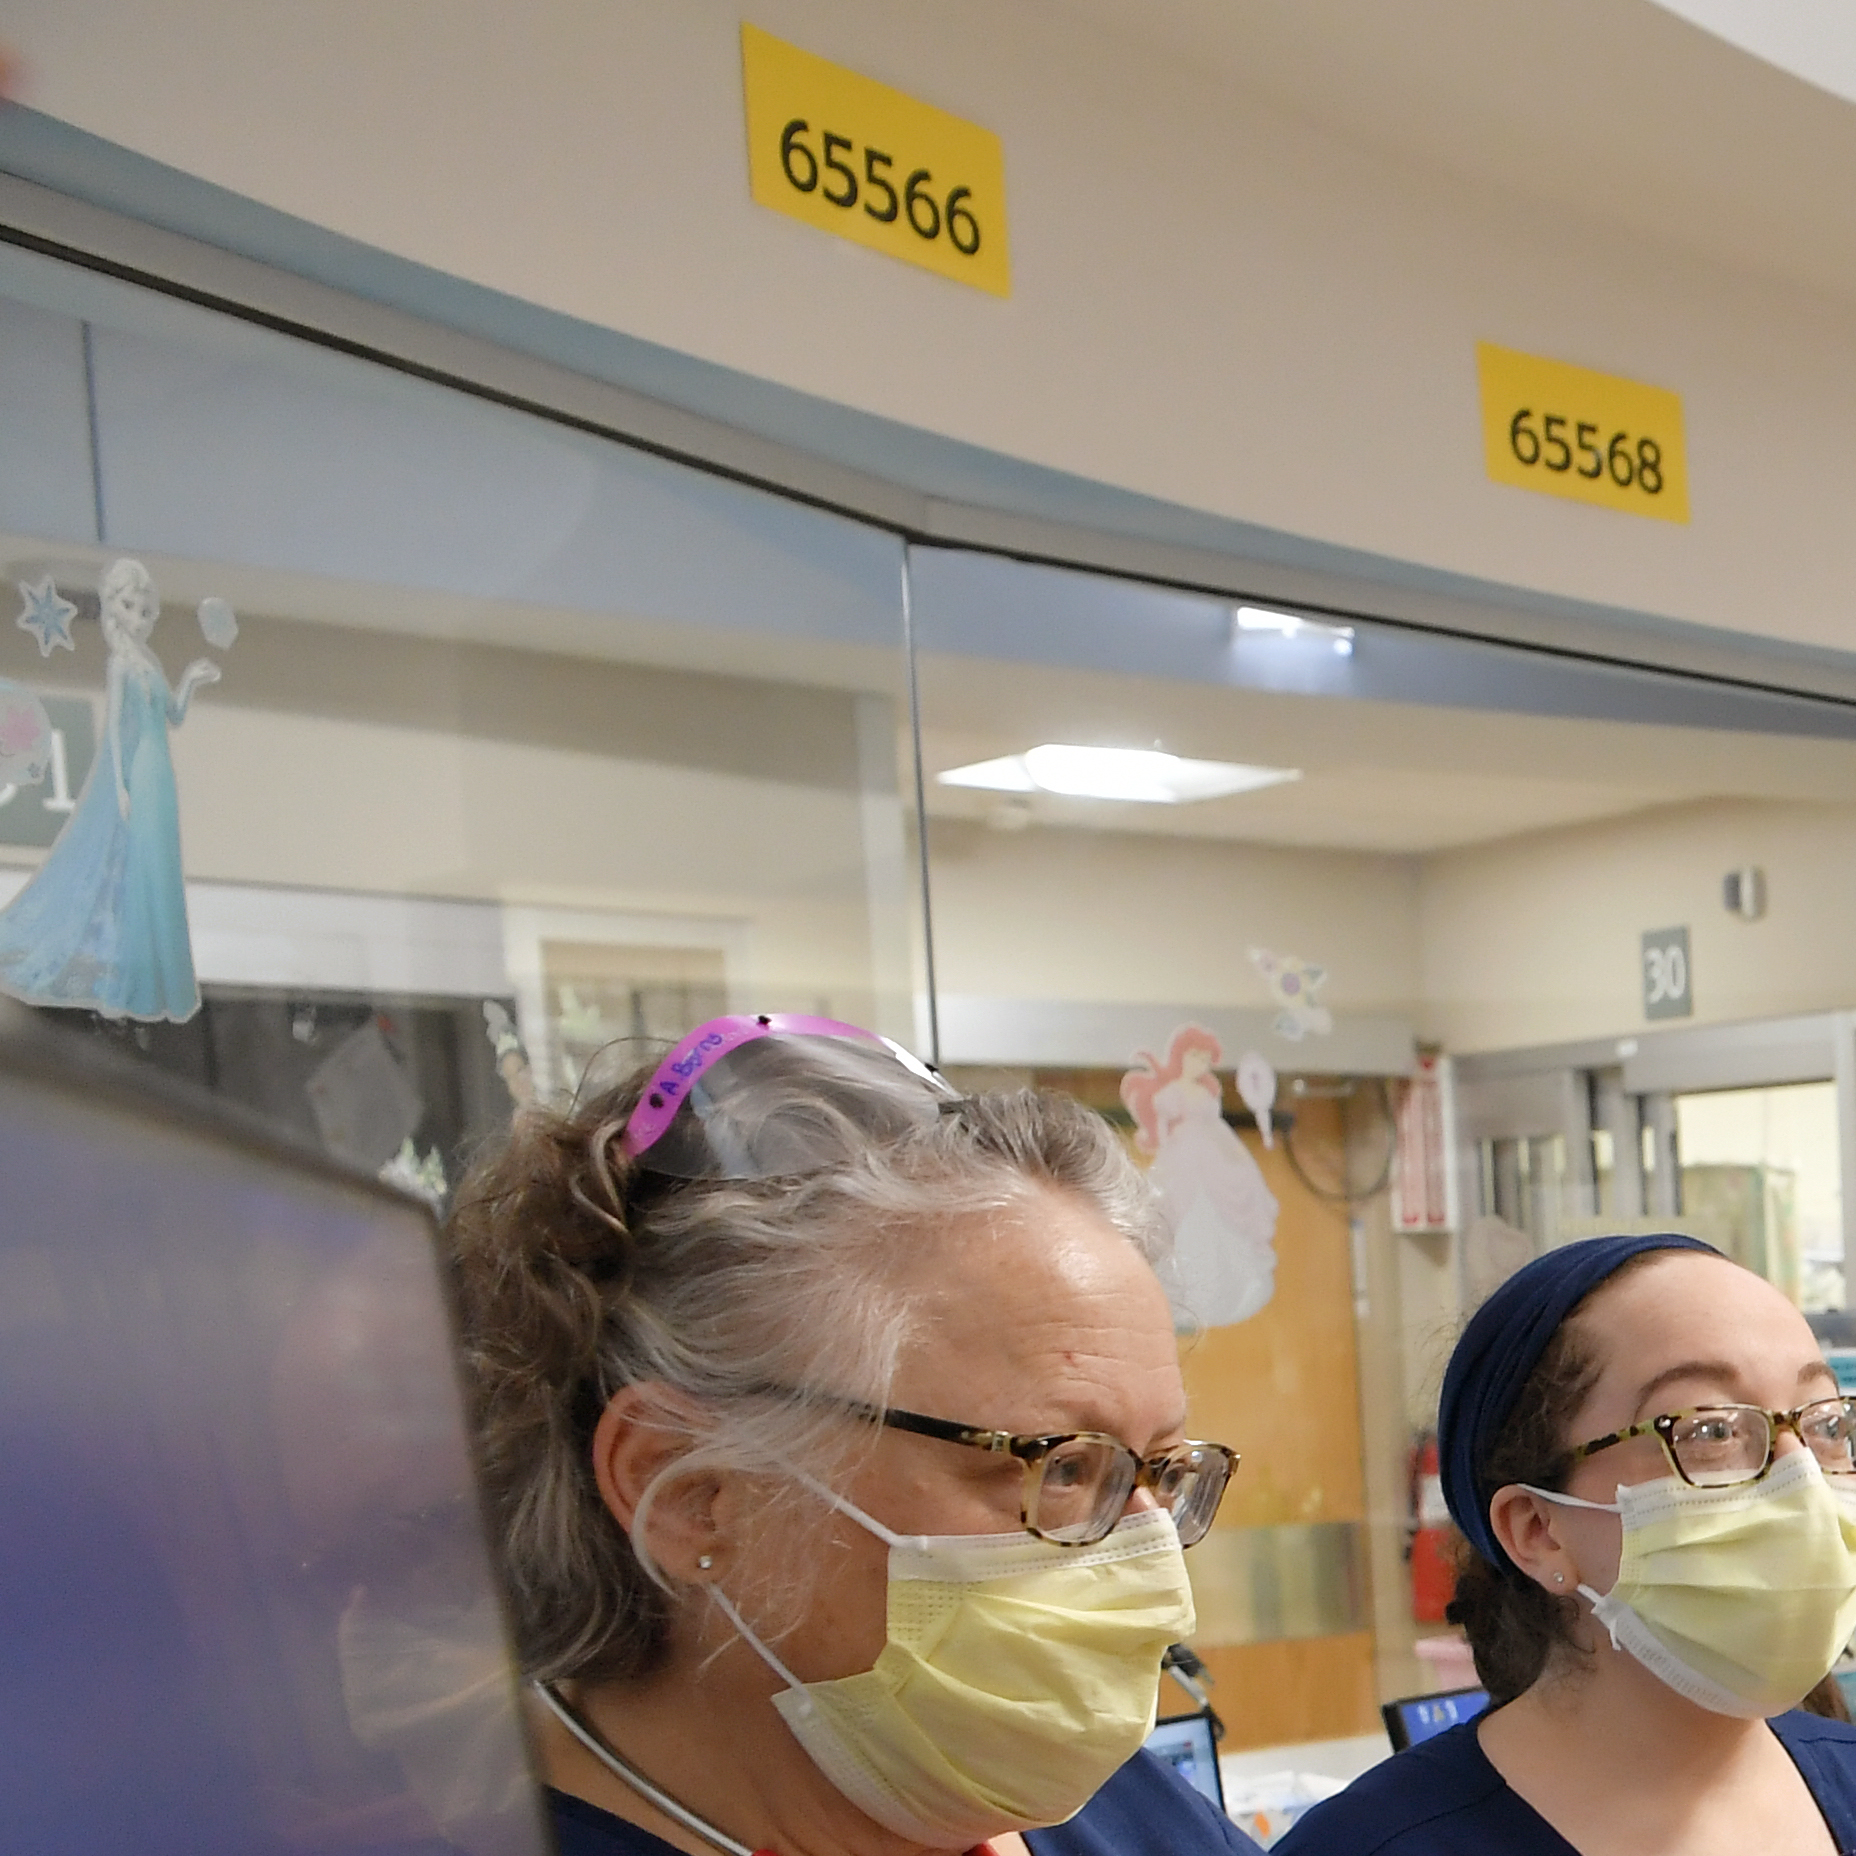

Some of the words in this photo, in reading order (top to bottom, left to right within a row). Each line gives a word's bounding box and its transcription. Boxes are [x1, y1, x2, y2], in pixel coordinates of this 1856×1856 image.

[779, 118, 980, 256] 65566
[1510, 408, 1663, 494] 65568
[1645, 945, 1686, 1004] 30
